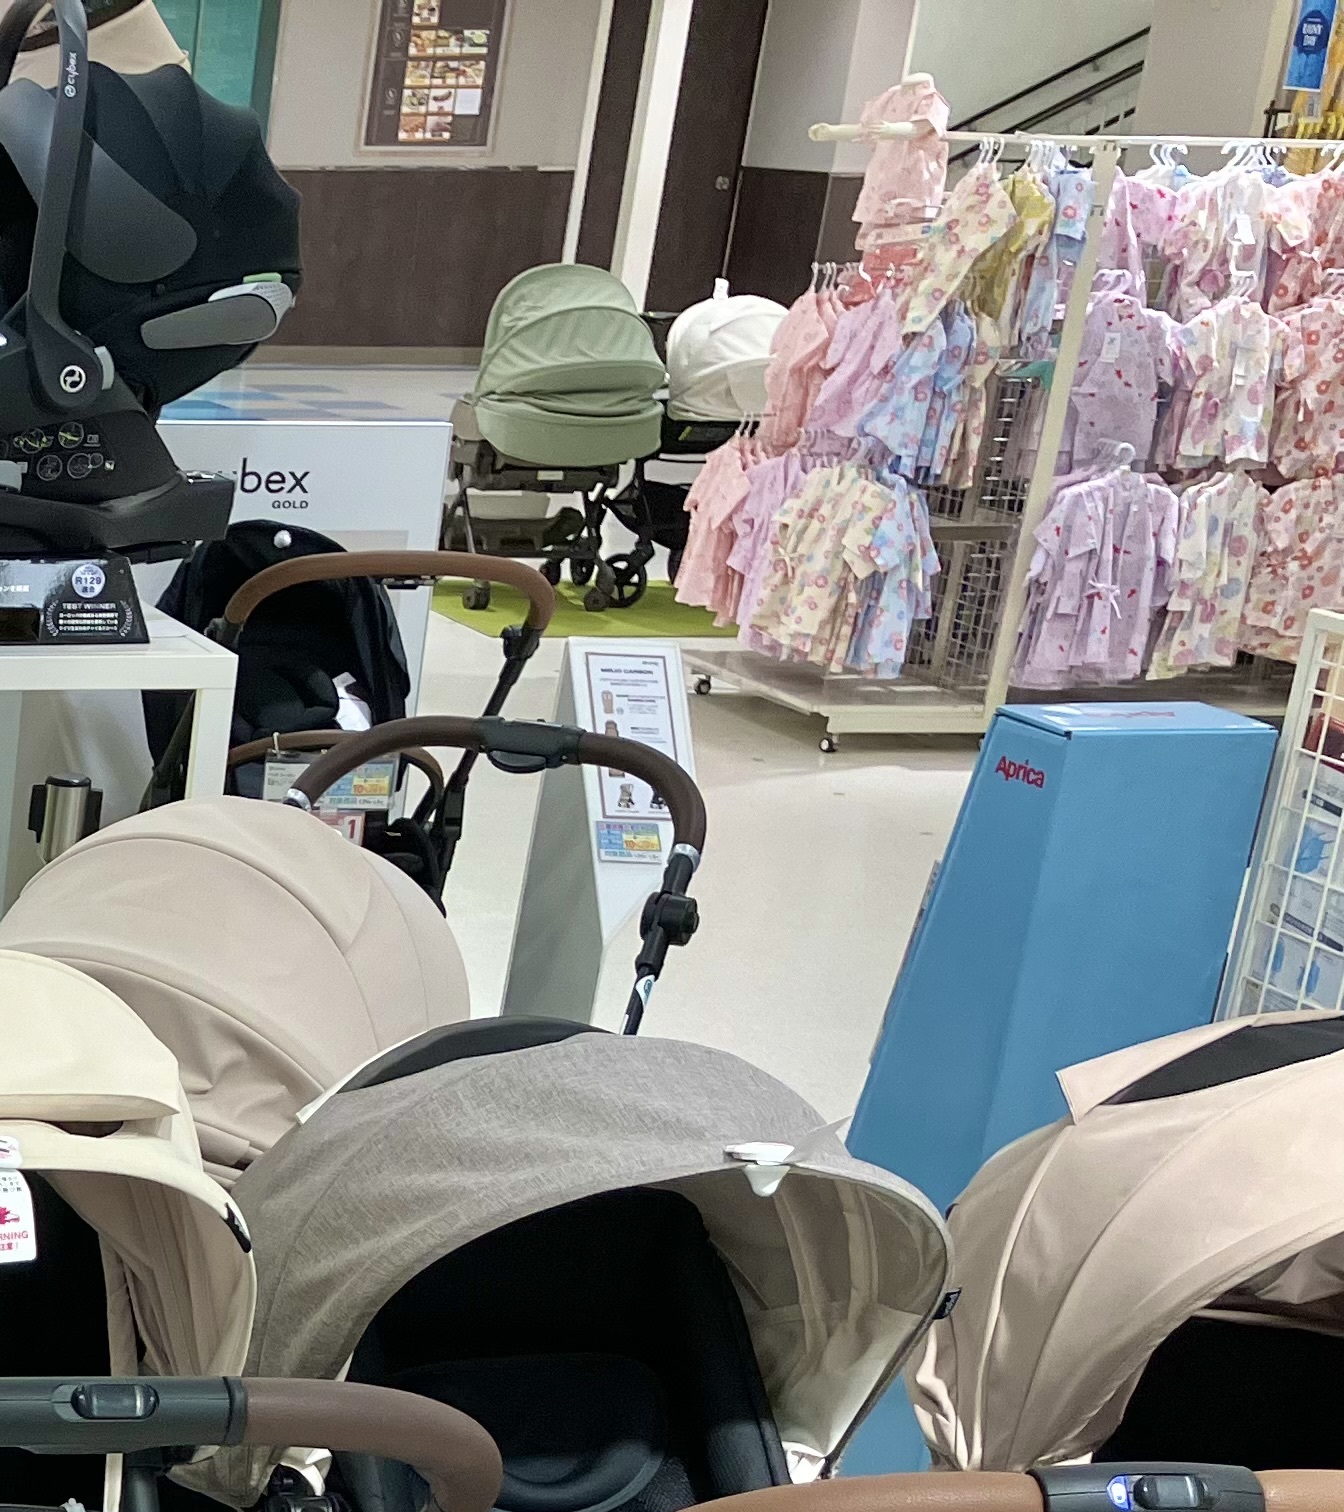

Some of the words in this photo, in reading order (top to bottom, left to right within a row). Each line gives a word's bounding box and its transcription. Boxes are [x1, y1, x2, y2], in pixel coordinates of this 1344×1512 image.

[271, 499, 309, 510] GOLD
[75, 577, 102, 585] R129
[994, 755, 1045, 790] Aprica
